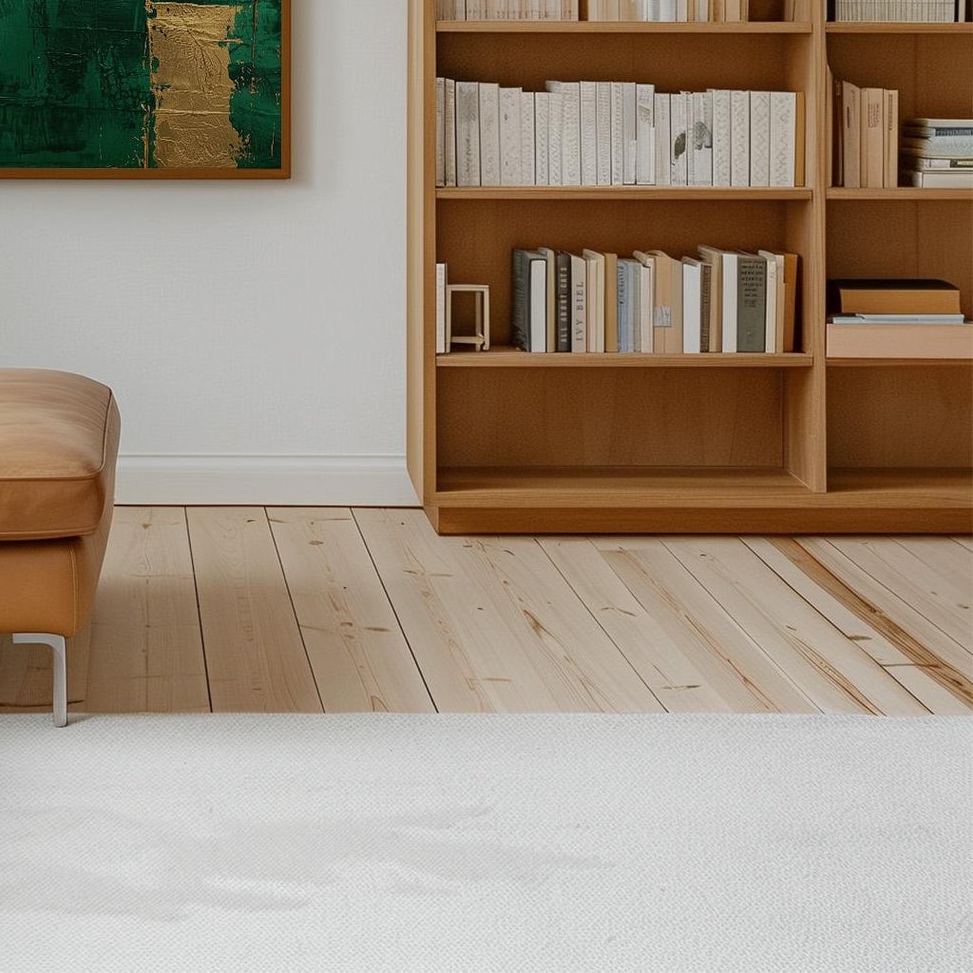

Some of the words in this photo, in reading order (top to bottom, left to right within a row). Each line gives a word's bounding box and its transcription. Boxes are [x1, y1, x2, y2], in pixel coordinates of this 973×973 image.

[576, 281, 584, 311] BIEL
[560, 331, 568, 343] ALL
[576, 319, 584, 341] IVY
